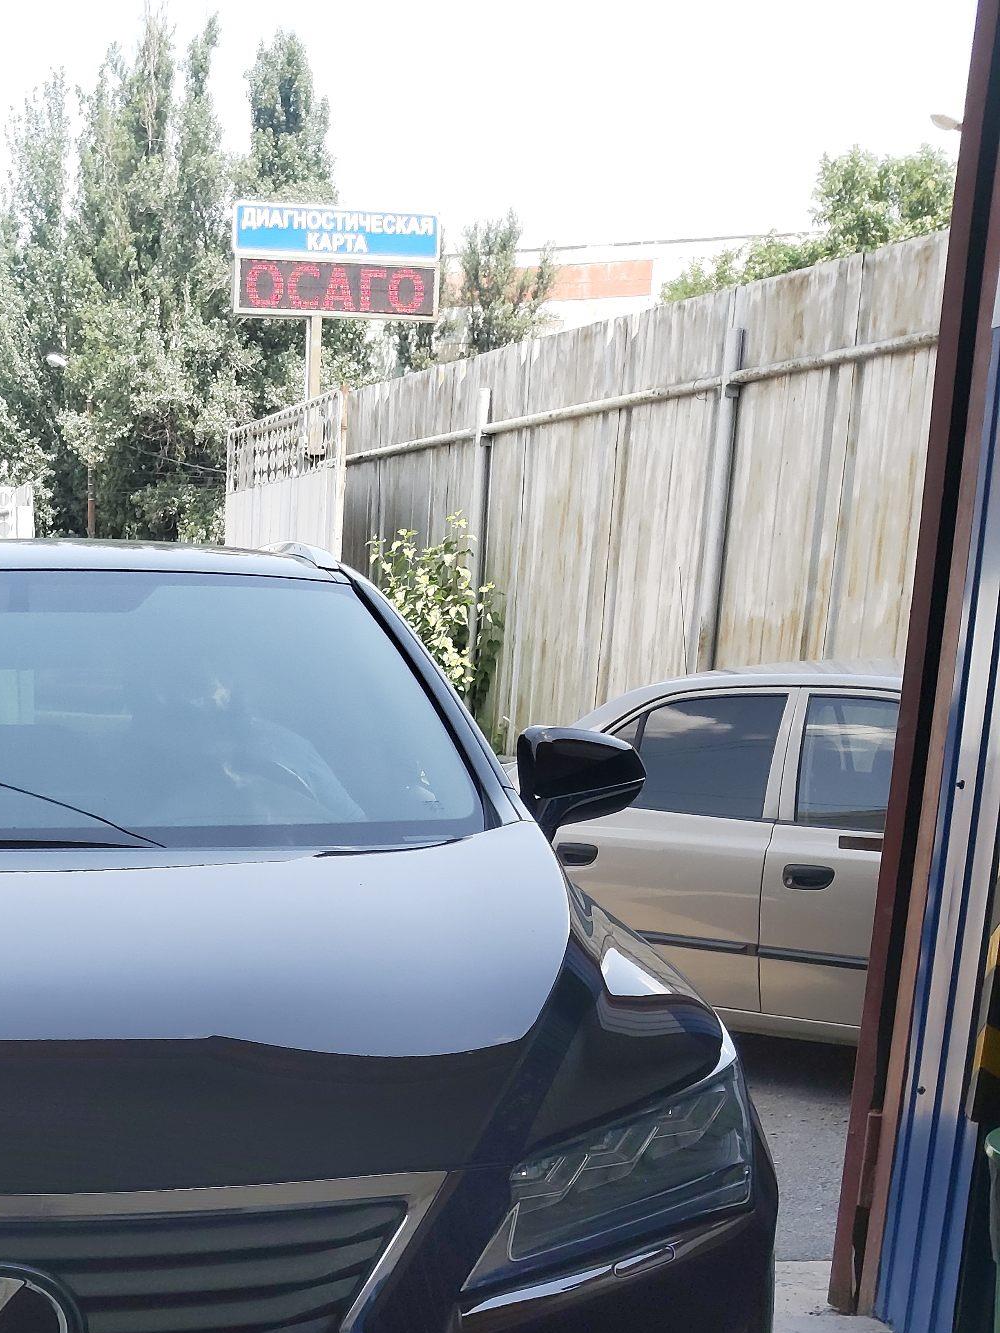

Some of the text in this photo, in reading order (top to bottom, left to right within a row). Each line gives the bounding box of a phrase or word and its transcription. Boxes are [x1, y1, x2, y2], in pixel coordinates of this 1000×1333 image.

[241, 207, 434, 235] ДИАГНОСТИЧЕСКАЯ
[307, 231, 369, 252] КАРТА
[246, 264, 425, 314] ОСАГО
